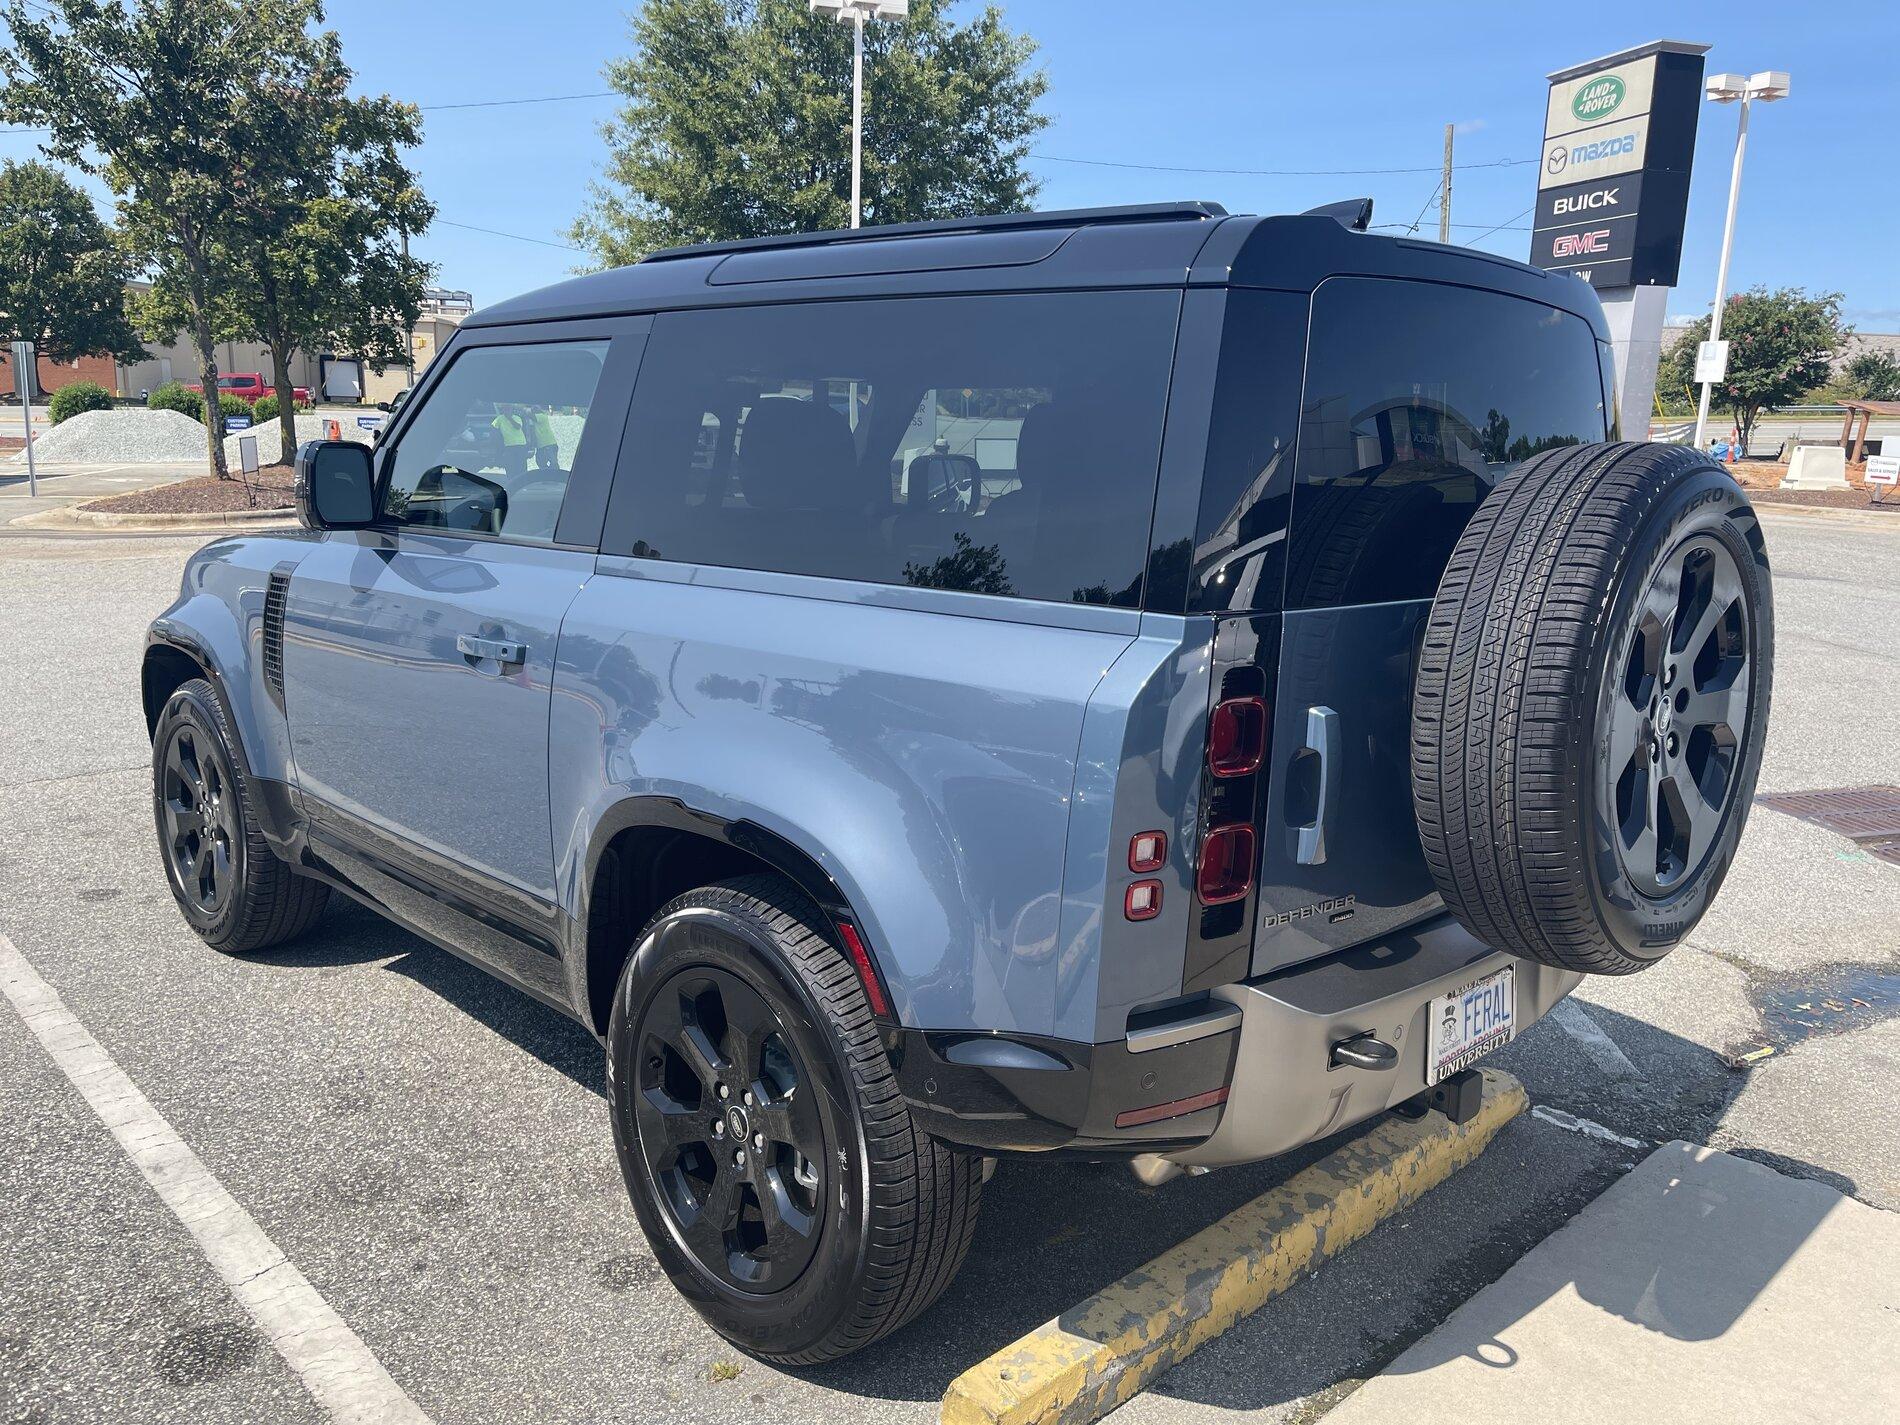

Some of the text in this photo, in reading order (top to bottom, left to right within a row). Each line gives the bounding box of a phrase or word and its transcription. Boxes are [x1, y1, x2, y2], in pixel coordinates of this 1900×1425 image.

[1582, 82, 1611, 102] LAND
[1583, 93, 1617, 114] ROVER
[1553, 187, 1620, 215] BUICK
[1553, 229, 1611, 258] GMC
[1264, 894, 1356, 929] DEFENDER
[1463, 981, 1510, 1041] FERAL
[1438, 1029, 1510, 1081] UNIVERSITY
